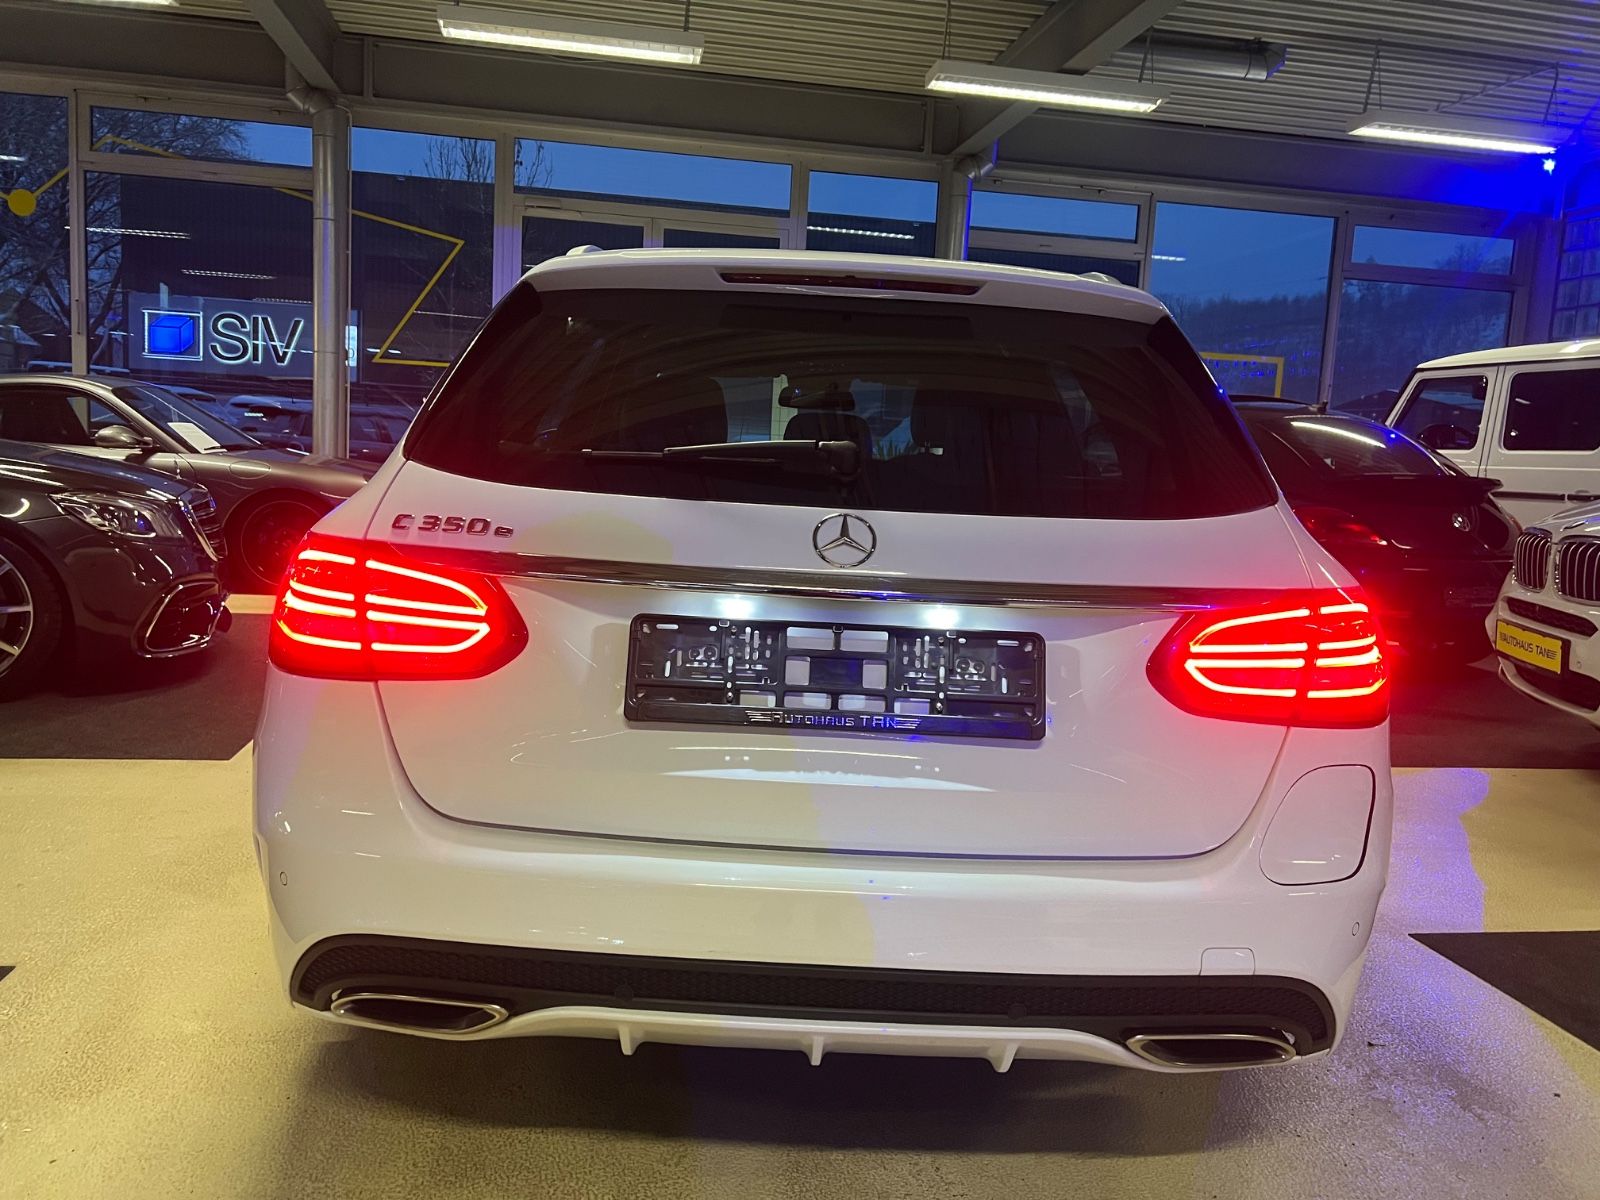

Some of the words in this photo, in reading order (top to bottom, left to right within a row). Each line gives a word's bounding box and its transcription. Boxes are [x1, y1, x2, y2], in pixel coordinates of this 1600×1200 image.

[209, 311, 304, 366] SIV
[392, 513, 415, 530] C
[418, 514, 491, 536] 350
[1503, 633, 1533, 653] AUTOHAUS
